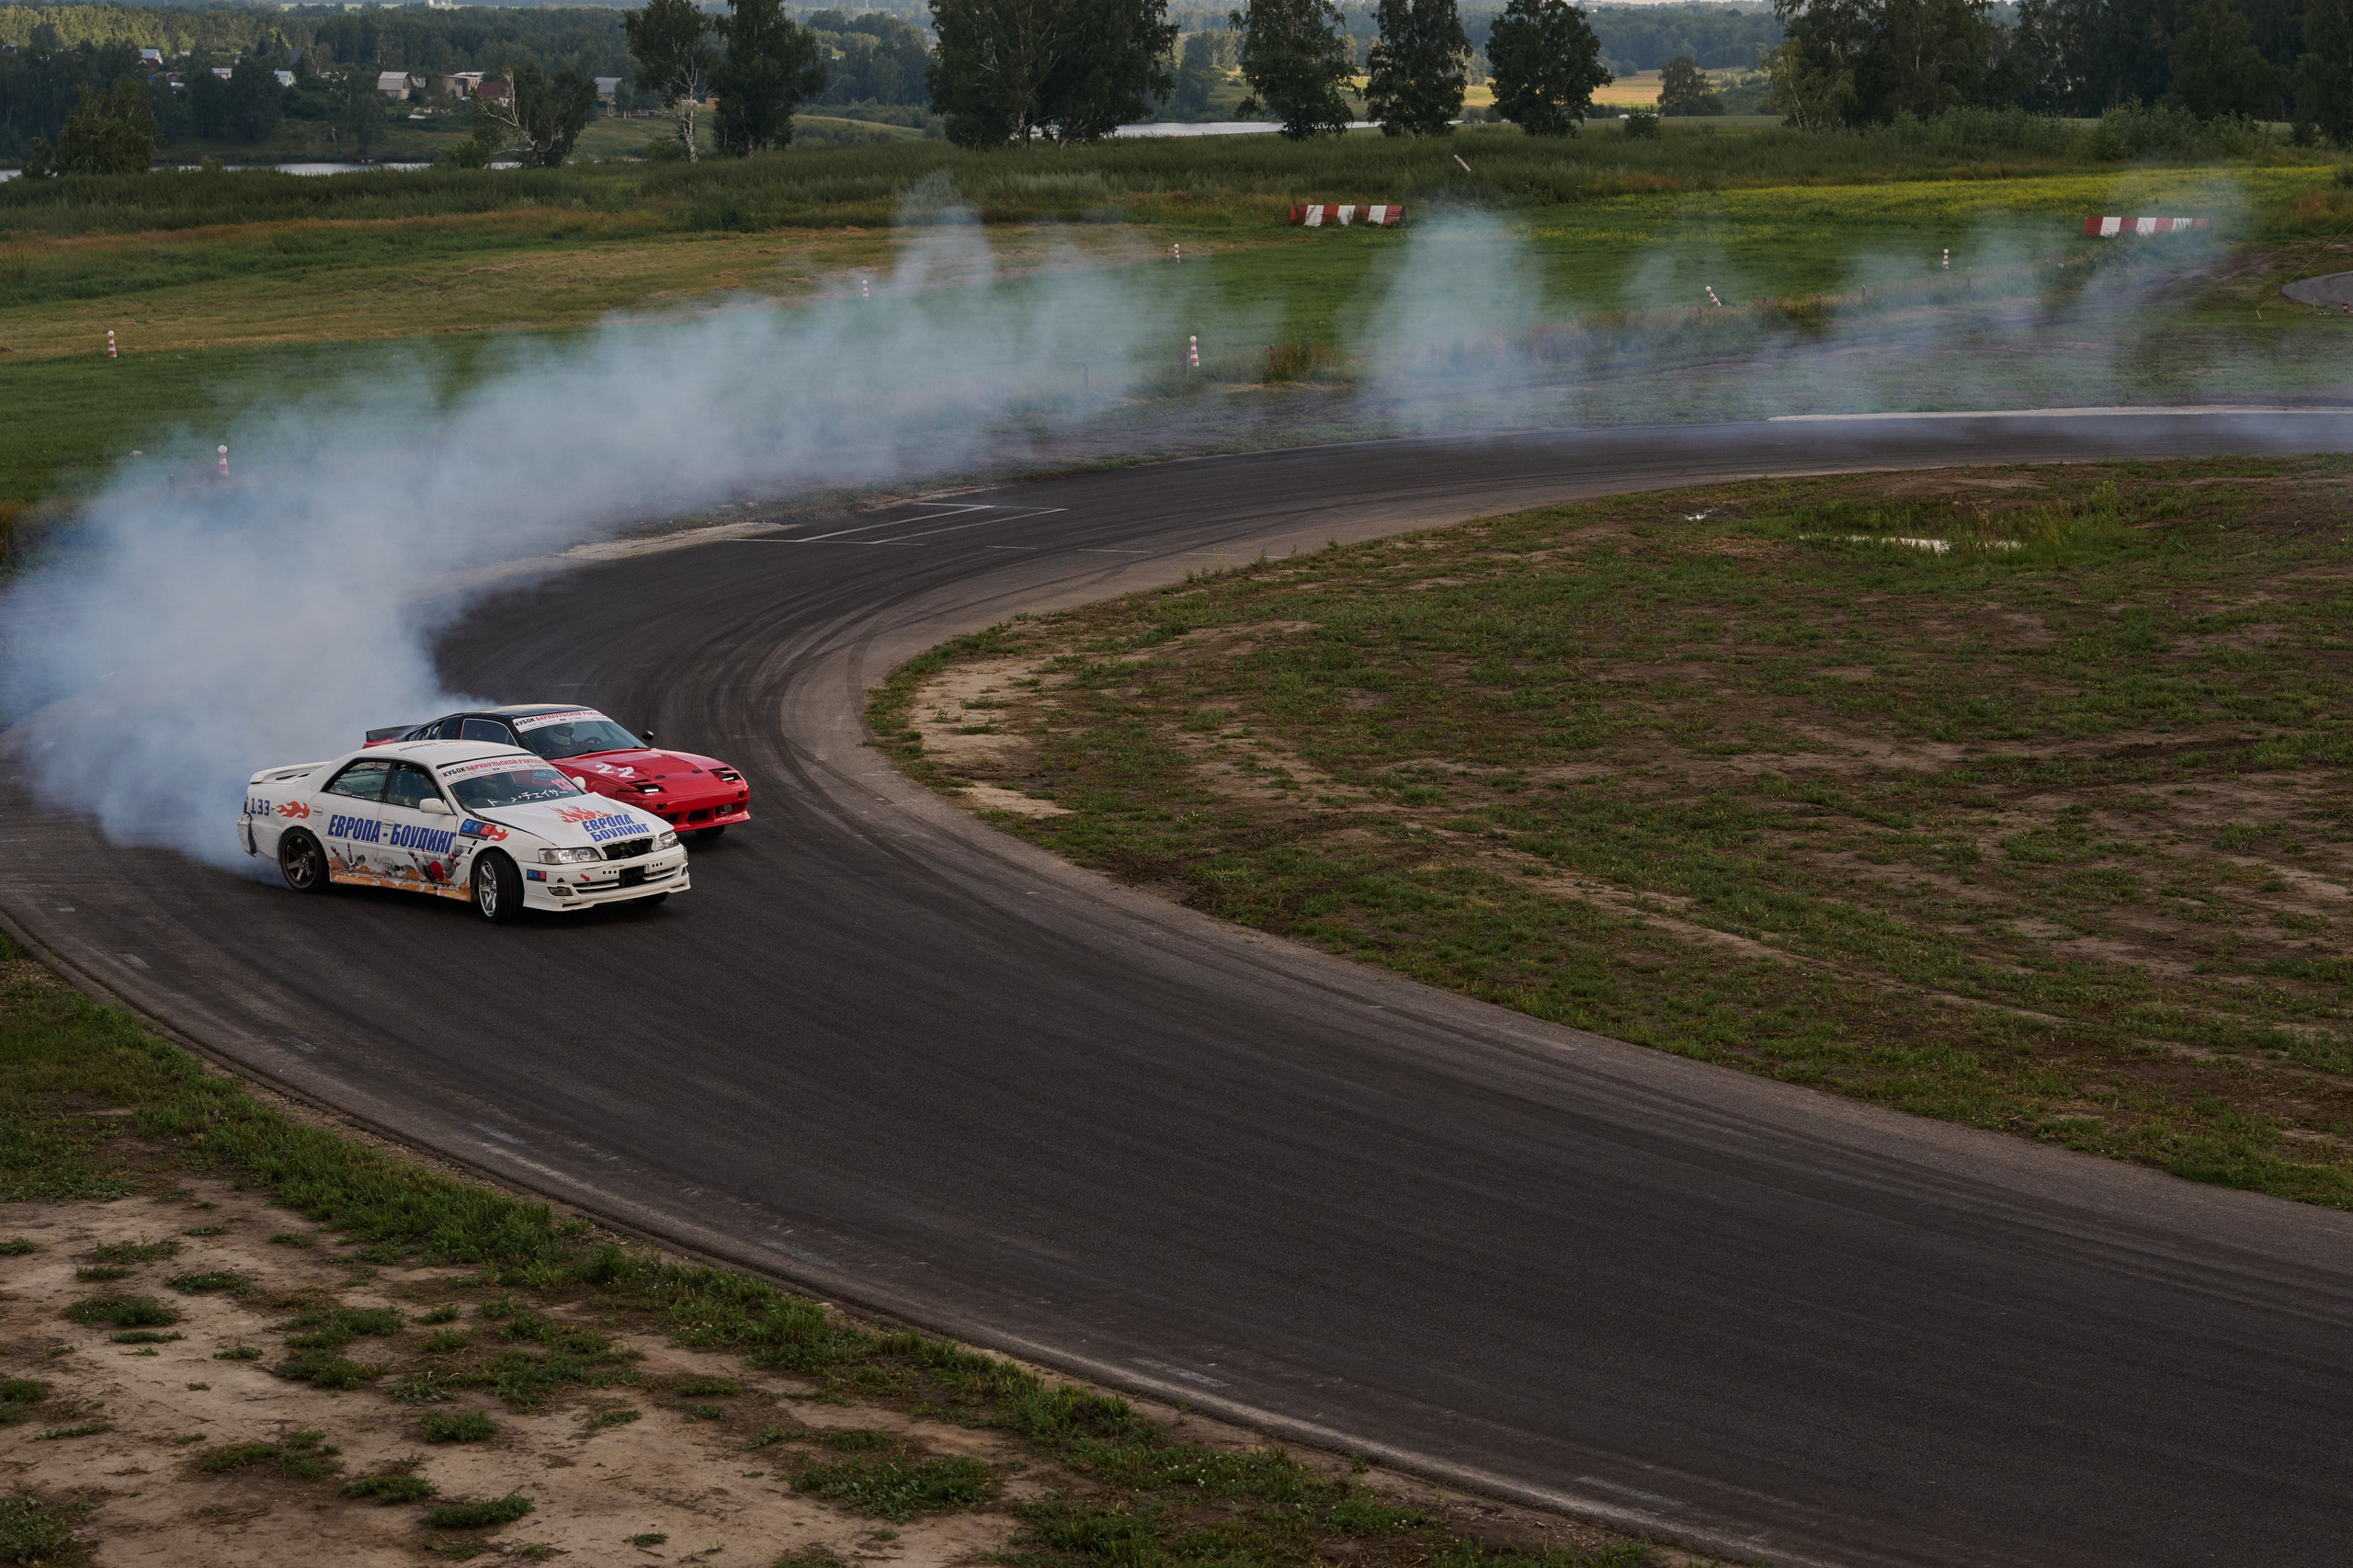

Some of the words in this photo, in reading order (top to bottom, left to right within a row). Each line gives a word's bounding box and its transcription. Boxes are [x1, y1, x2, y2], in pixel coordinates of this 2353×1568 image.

[515, 717, 536, 727] КУБОК
[442, 767, 467, 778] КУБОК
[465, 758, 517, 770] БАРНАУЛЬСКОЙ
[596, 764, 635, 778] 22
[250, 797, 270, 817] 133
[462, 819, 494, 835] SKR
[581, 813, 635, 833] ЕВРОПА
[589, 823, 651, 843] БОУЛИНГ
[327, 813, 382, 843] ЕВРОПА
[389, 823, 458, 855] БОУЛИНГ
